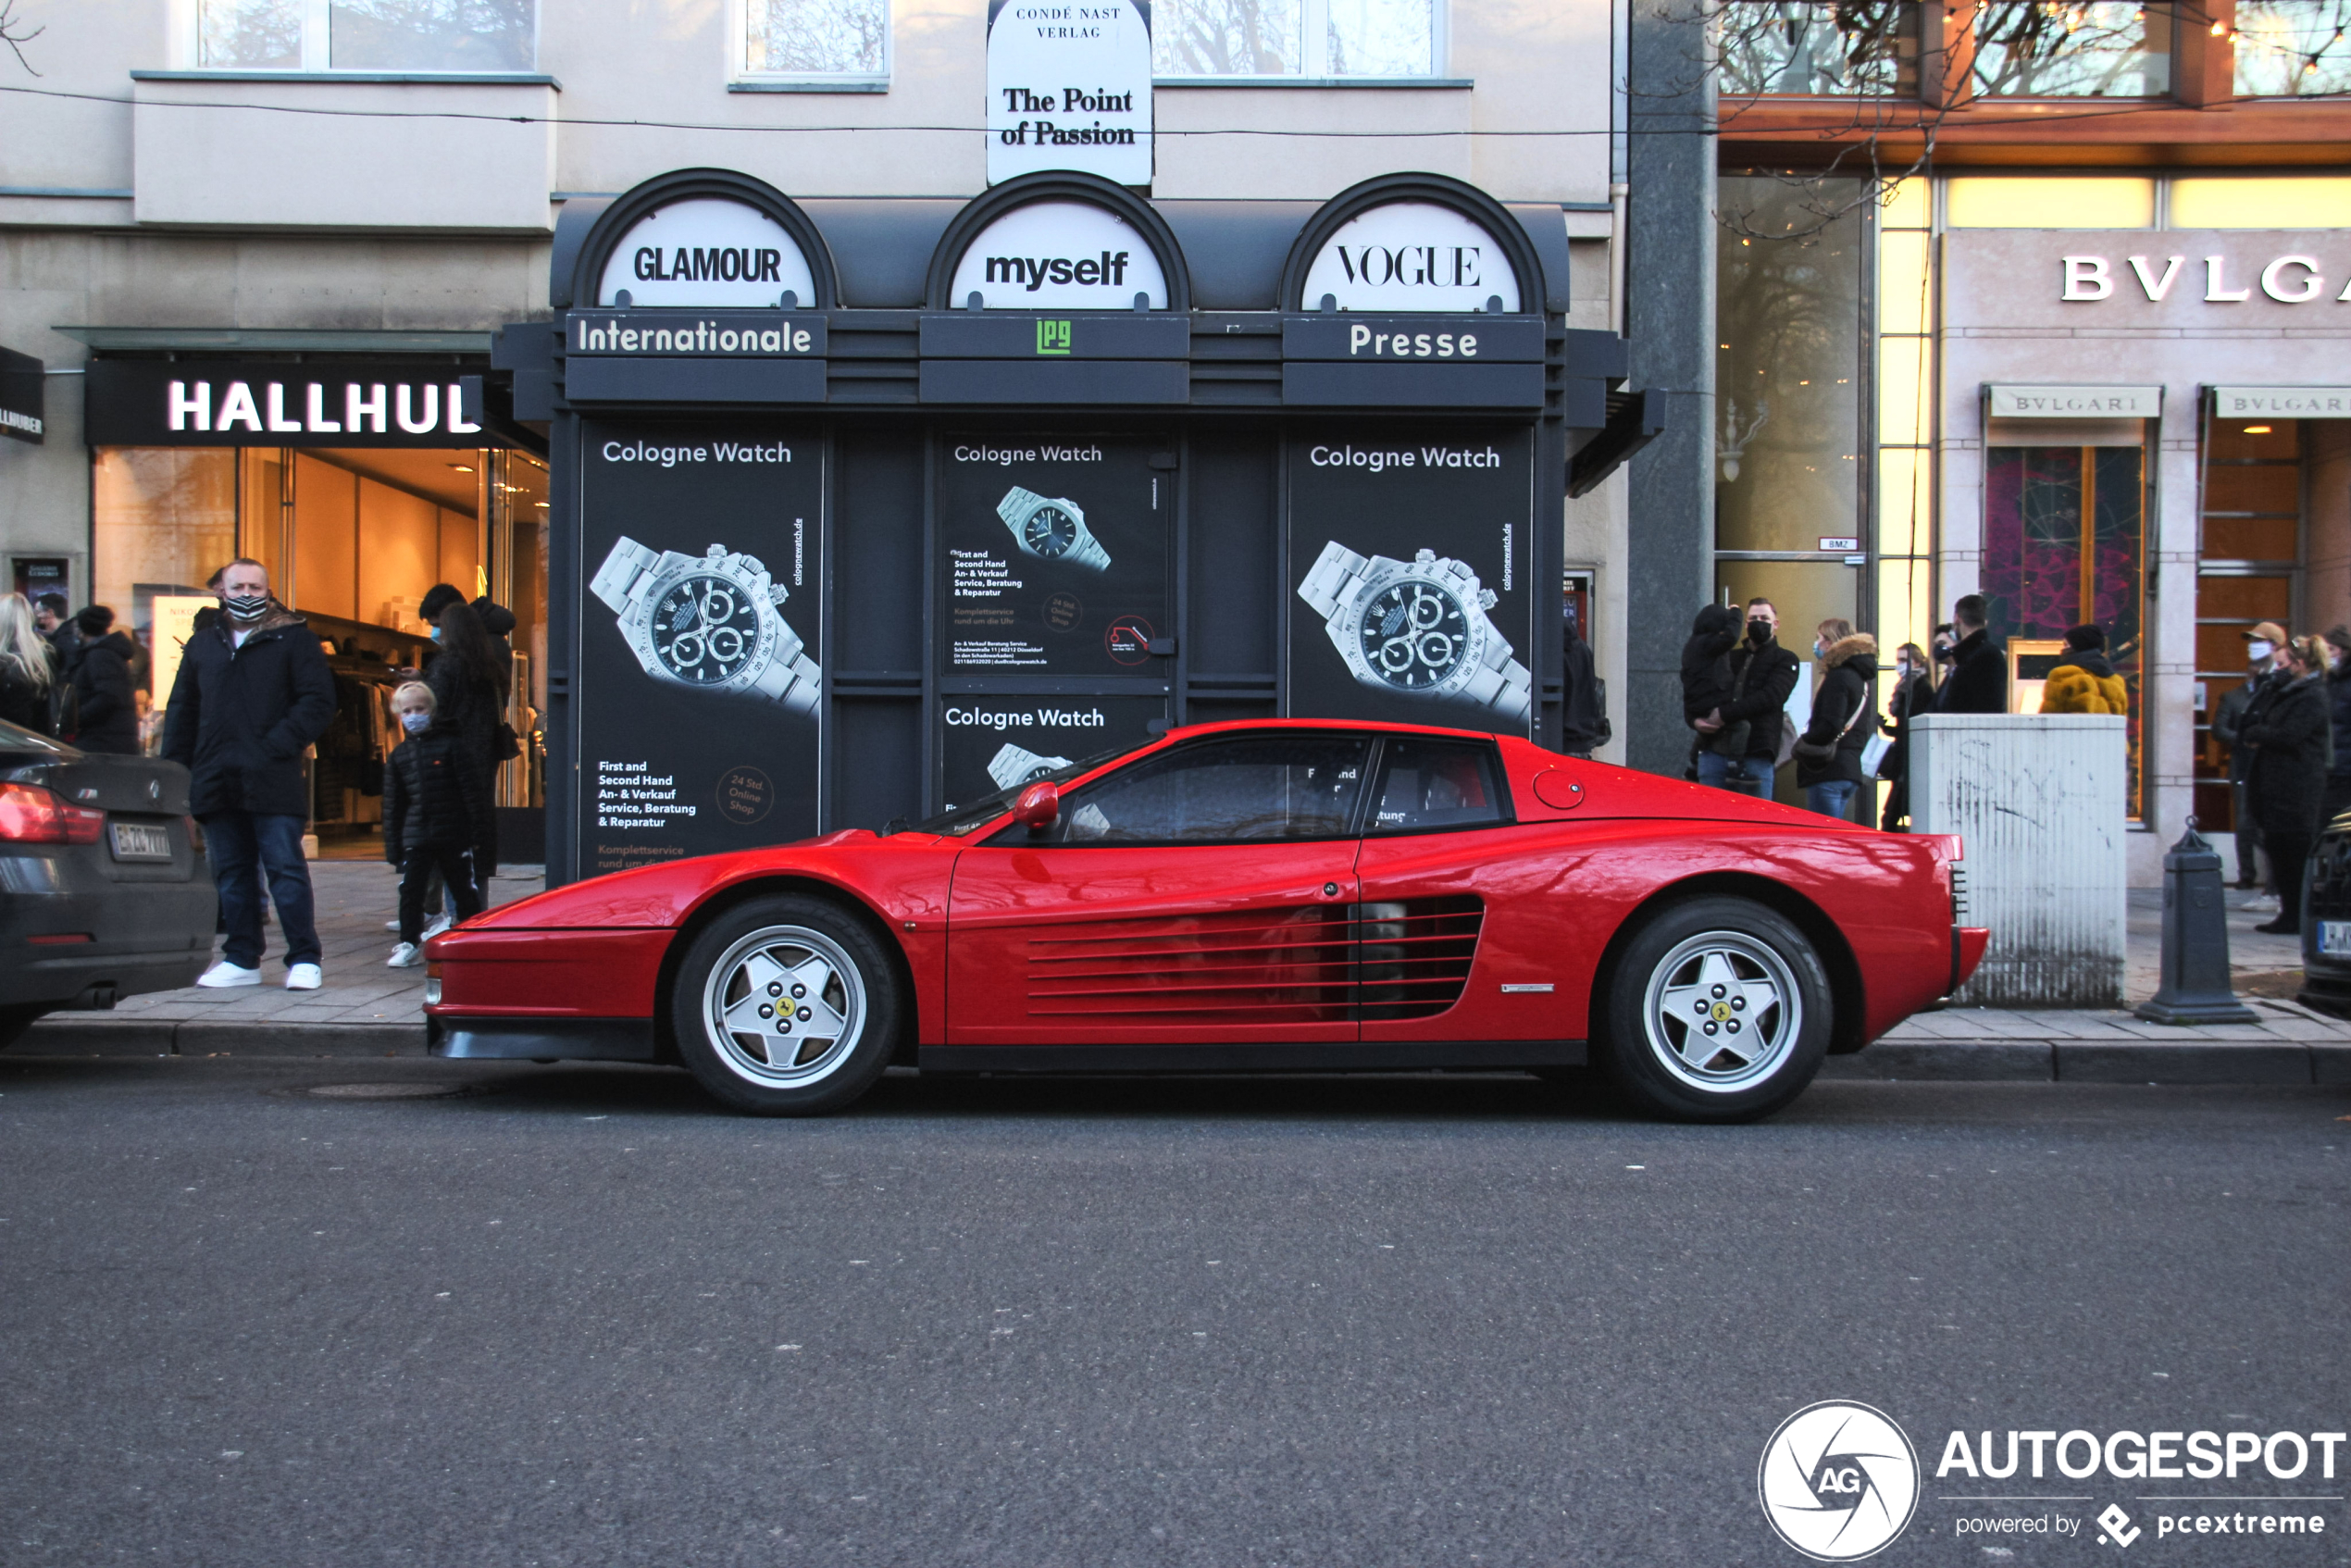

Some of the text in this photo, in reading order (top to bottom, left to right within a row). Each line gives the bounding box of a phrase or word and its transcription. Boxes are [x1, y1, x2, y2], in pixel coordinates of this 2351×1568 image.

[1016, 6, 1121, 19] CONDÉ NAST
[1037, 27, 1101, 38] VERLAG
[1002, 87, 1133, 113] The Point
[1001, 120, 1136, 145] of Passion
[634, 247, 781, 282] GLAMOUR
[986, 251, 1128, 292] myself
[1334, 245, 1481, 288] VOGUE
[578, 319, 812, 353] Internationale
[1350, 325, 1477, 357] Presse
[2015, 396, 2138, 411] BVLGARI
[603, 441, 791, 467] Cologne Watch
[954, 445, 1102, 465] Cologne Watch
[1311, 445, 1500, 472] Cologne Watch
[794, 518, 802, 586] colognewatch.de
[1503, 523, 1511, 591] colognewatch.de
[977, 569, 1009, 578] Verkauf
[954, 579, 1023, 589] Service, Beratung
[963, 589, 1001, 598] Reparatur
[954, 608, 1014, 616] Komplettservice
[1051, 607, 1074, 617] Online
[753, 662, 763, 671] 120
[1463, 667, 1472, 677] 120
[945, 707, 1104, 730] Cologne Watch
[599, 761, 647, 771] First and
[599, 775, 673, 786] Second Hand
[731, 775, 765, 790] 24 Std.
[599, 789, 676, 800] An- & Verkauf
[728, 788, 761, 803] Online
[599, 803, 696, 816] Service, Beratung
[729, 801, 754, 815] Shop
[599, 817, 665, 829] & Reparatur
[598, 845, 684, 856] Komplettservice
[598, 859, 622, 868] rund
